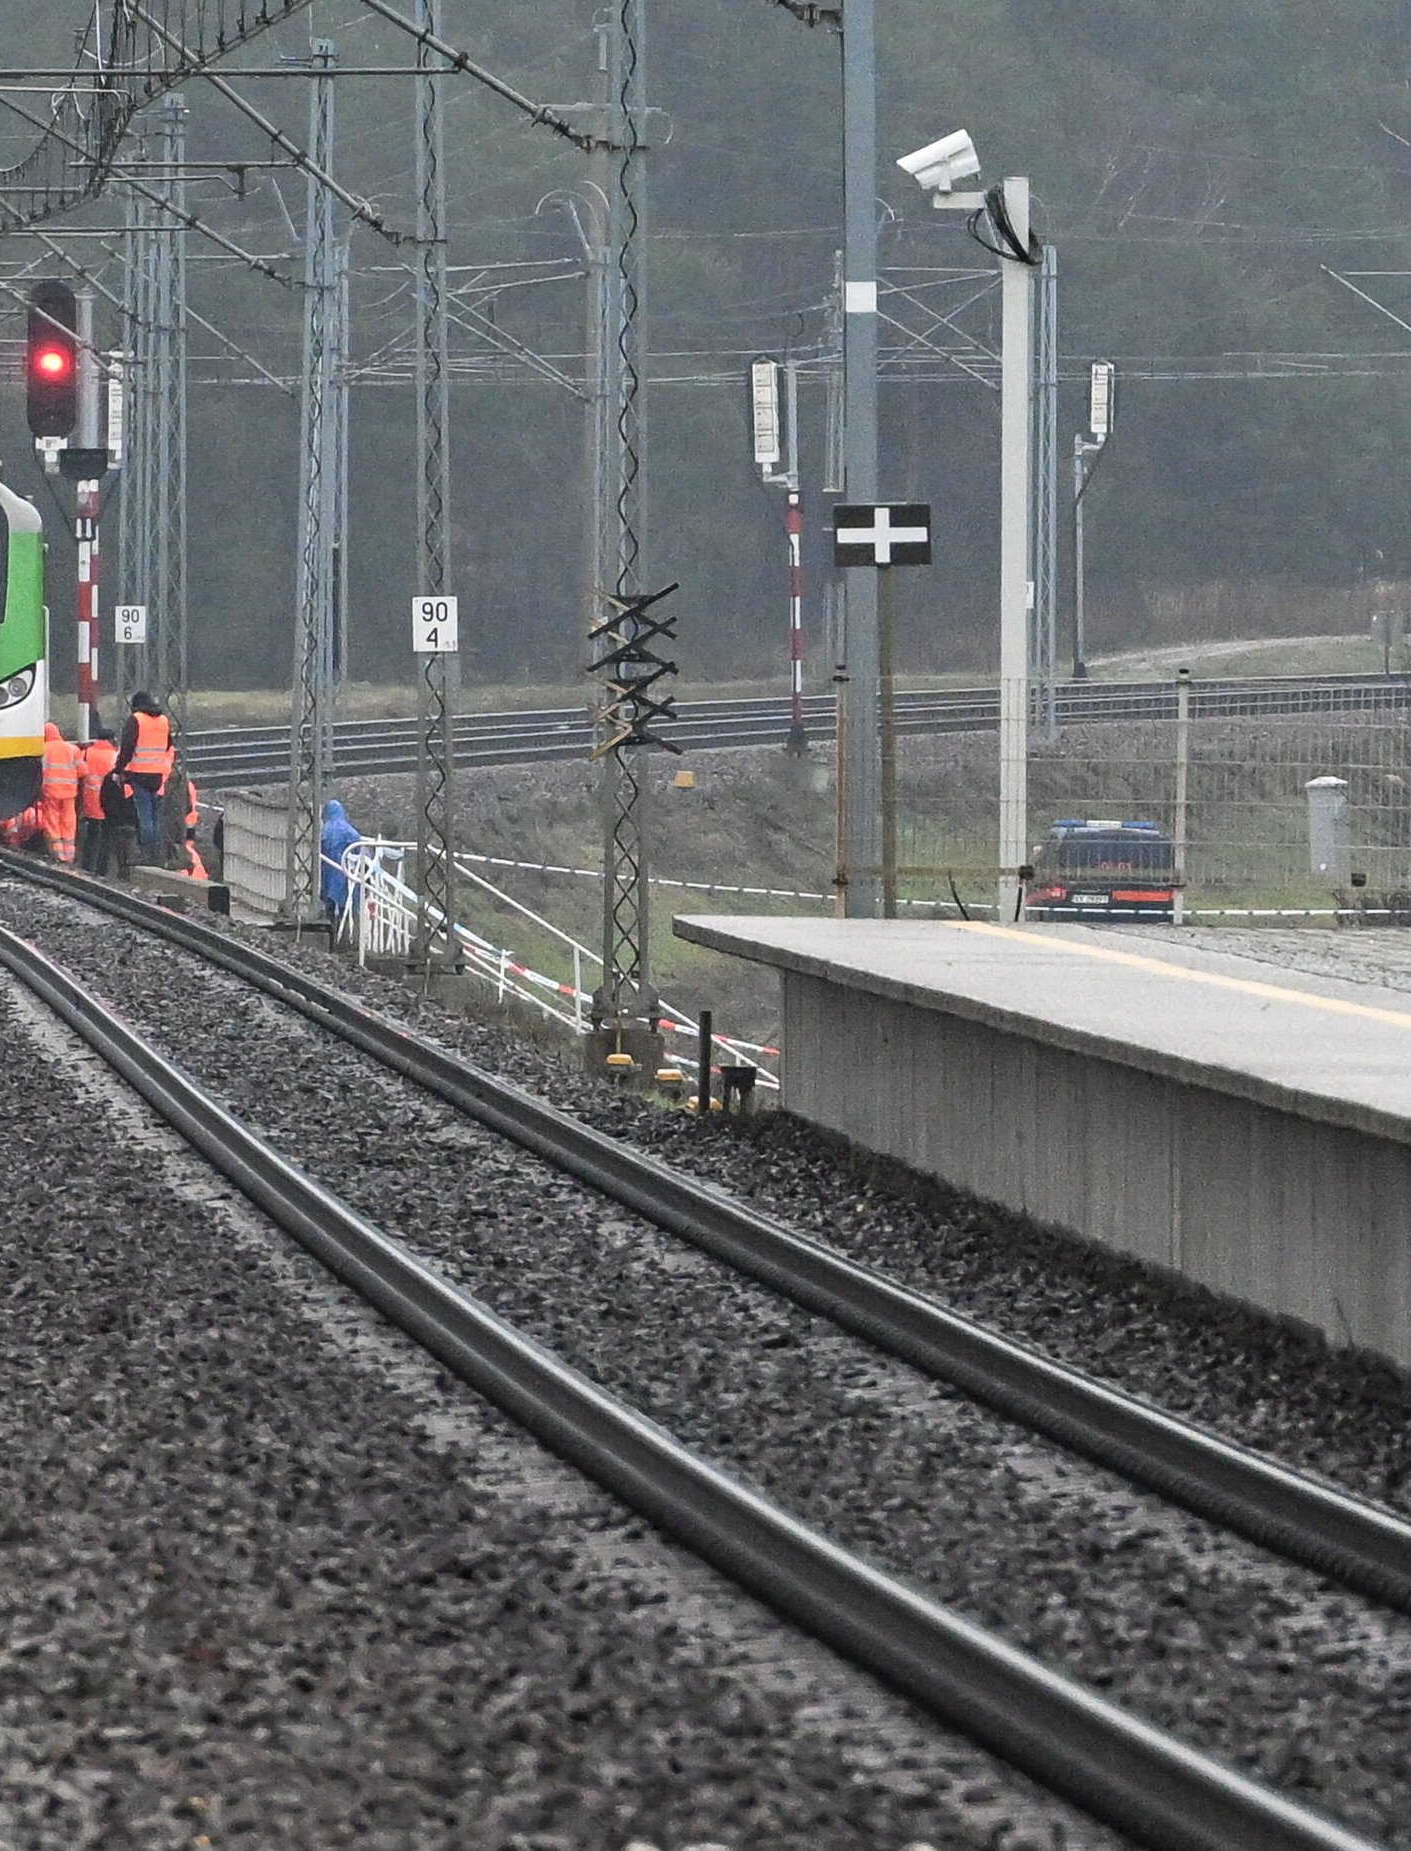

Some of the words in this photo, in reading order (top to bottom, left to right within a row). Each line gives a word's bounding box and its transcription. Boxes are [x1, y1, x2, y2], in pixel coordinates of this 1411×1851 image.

[122, 609, 140, 623] 90
[422, 601, 448, 622] 90
[124, 626, 133, 640] 6
[426, 627, 438, 648] 4
